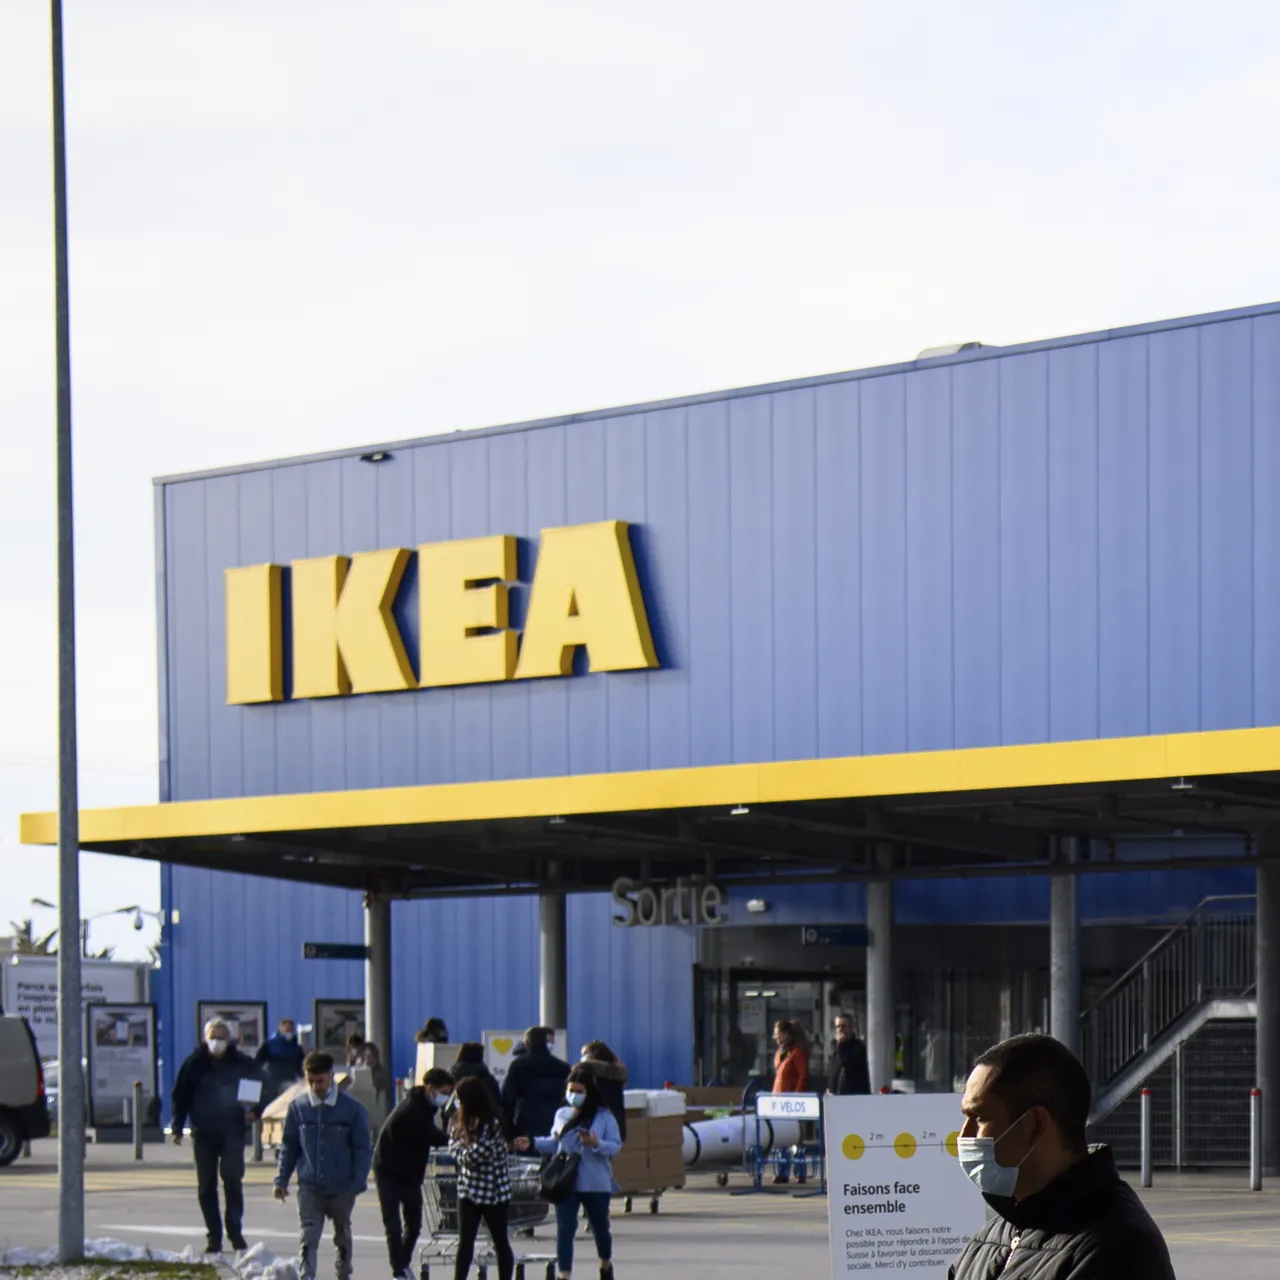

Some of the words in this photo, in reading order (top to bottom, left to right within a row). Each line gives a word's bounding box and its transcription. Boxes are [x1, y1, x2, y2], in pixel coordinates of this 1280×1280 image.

[224, 519, 660, 705] IKEA
[612, 874, 723, 927] Sortie
[869, 1132, 875, 1141] 2
[922, 1131, 927, 1139] 2
[843, 1182, 891, 1196] Faisons
[893, 1181, 921, 1195] face
[844, 1200, 906, 1215] ensemble
[845, 1229, 864, 1238] Chez
[905, 1226, 931, 1236] faisons
[932, 1226, 952, 1234] notre
[846, 1239, 876, 1250] possible
[877, 1240, 894, 1249] pour
[896, 1237, 930, 1248] répondre
[931, 1237, 936, 1245] à
[937, 1235, 961, 1247] l'appel
[961, 1235, 971, 1243] de
[846, 1251, 869, 1260] Suisse
[870, 1250, 876, 1259] à
[877, 1248, 908, 1259] favoriser
[910, 1247, 917, 1256] la
[918, 1246, 963, 1256] distanciation
[875, 1260, 895, 1269] Merci
